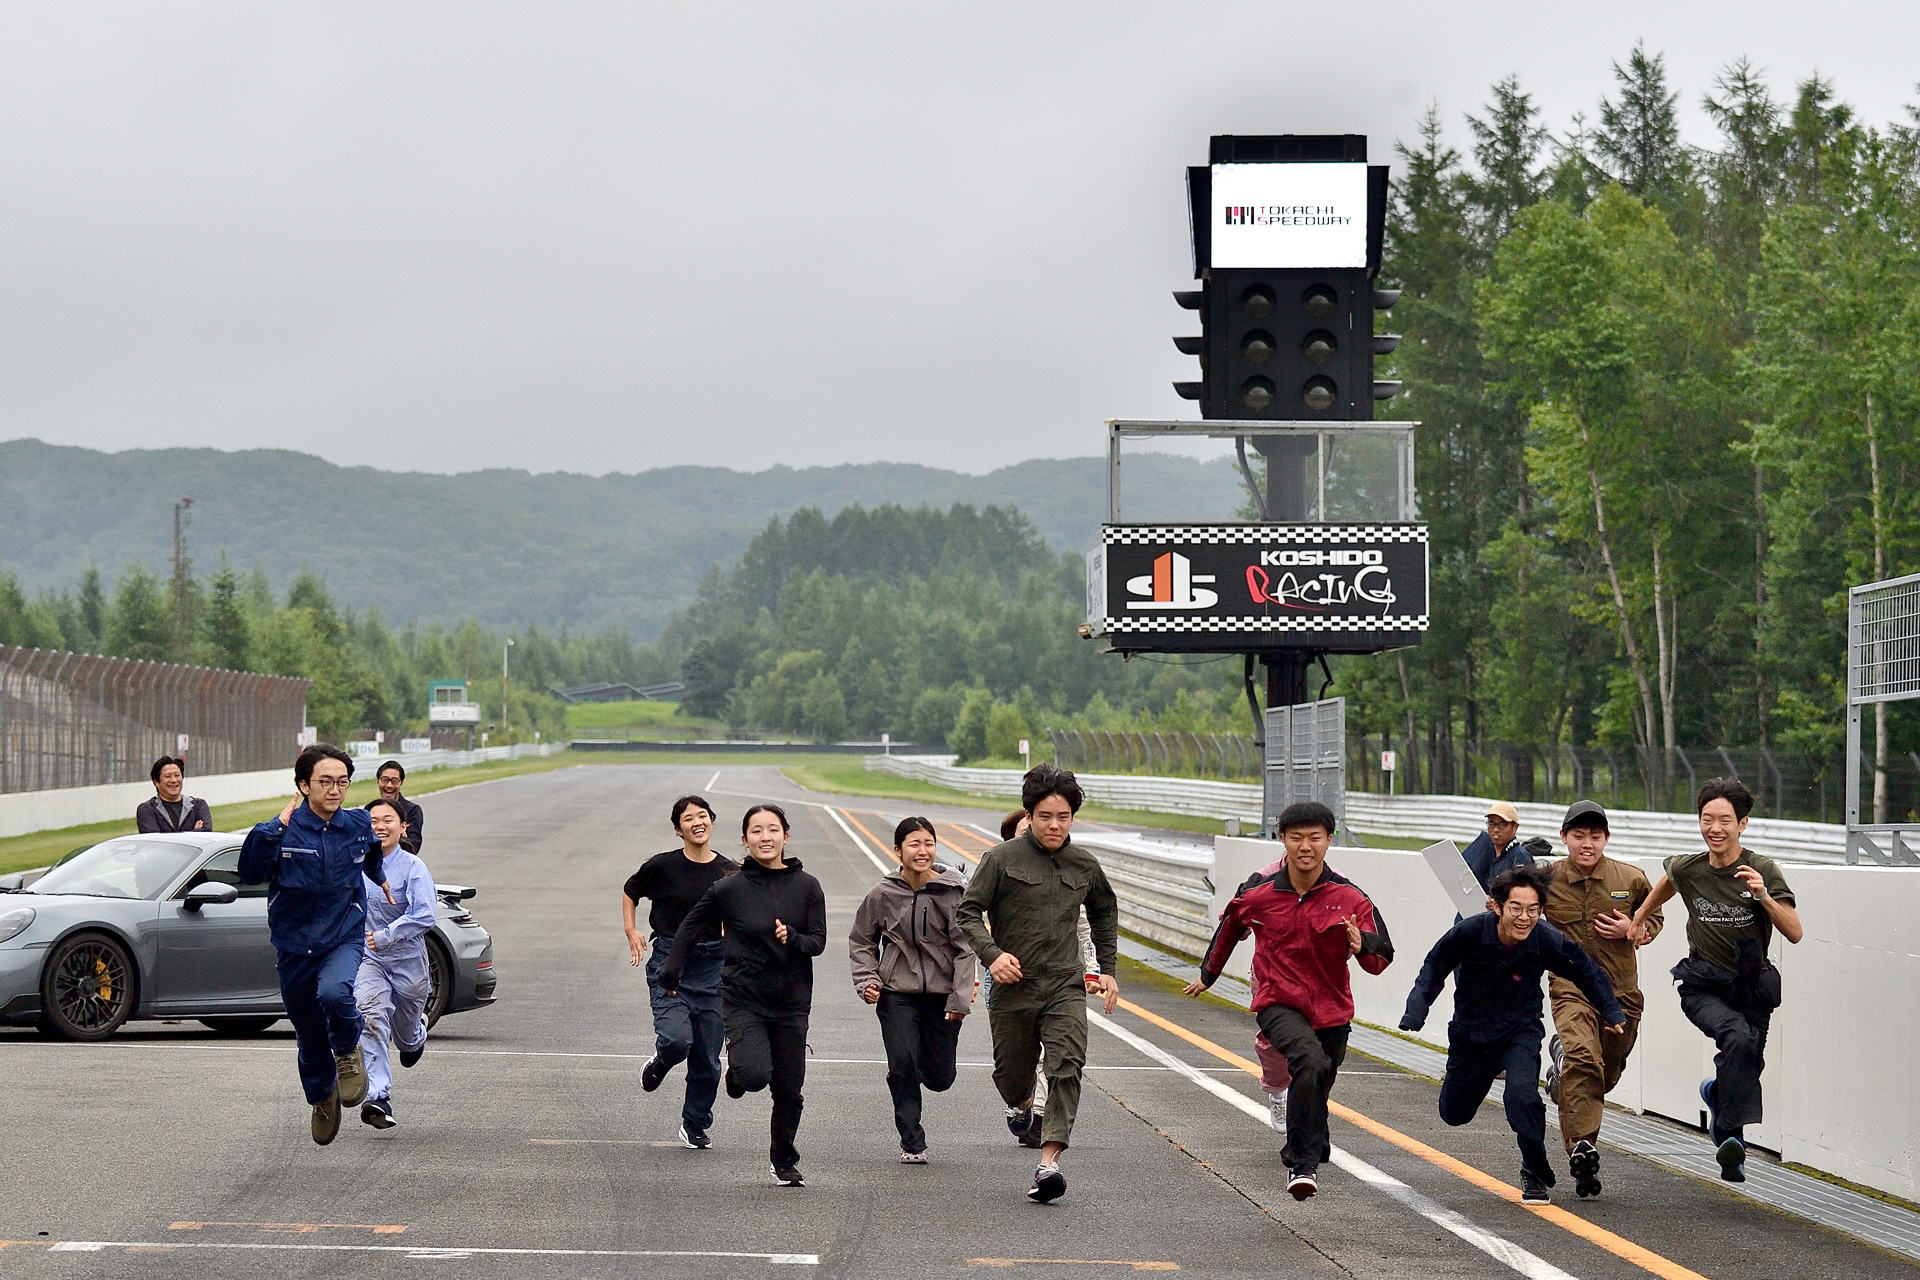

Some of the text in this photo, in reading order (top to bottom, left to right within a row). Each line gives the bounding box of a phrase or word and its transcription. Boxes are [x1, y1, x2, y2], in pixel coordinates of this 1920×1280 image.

[1258, 206, 1334, 215] TOKACHI
[1257, 217, 1352, 226] SPEEDWAY
[1260, 549, 1383, 566] KOSHIDO
